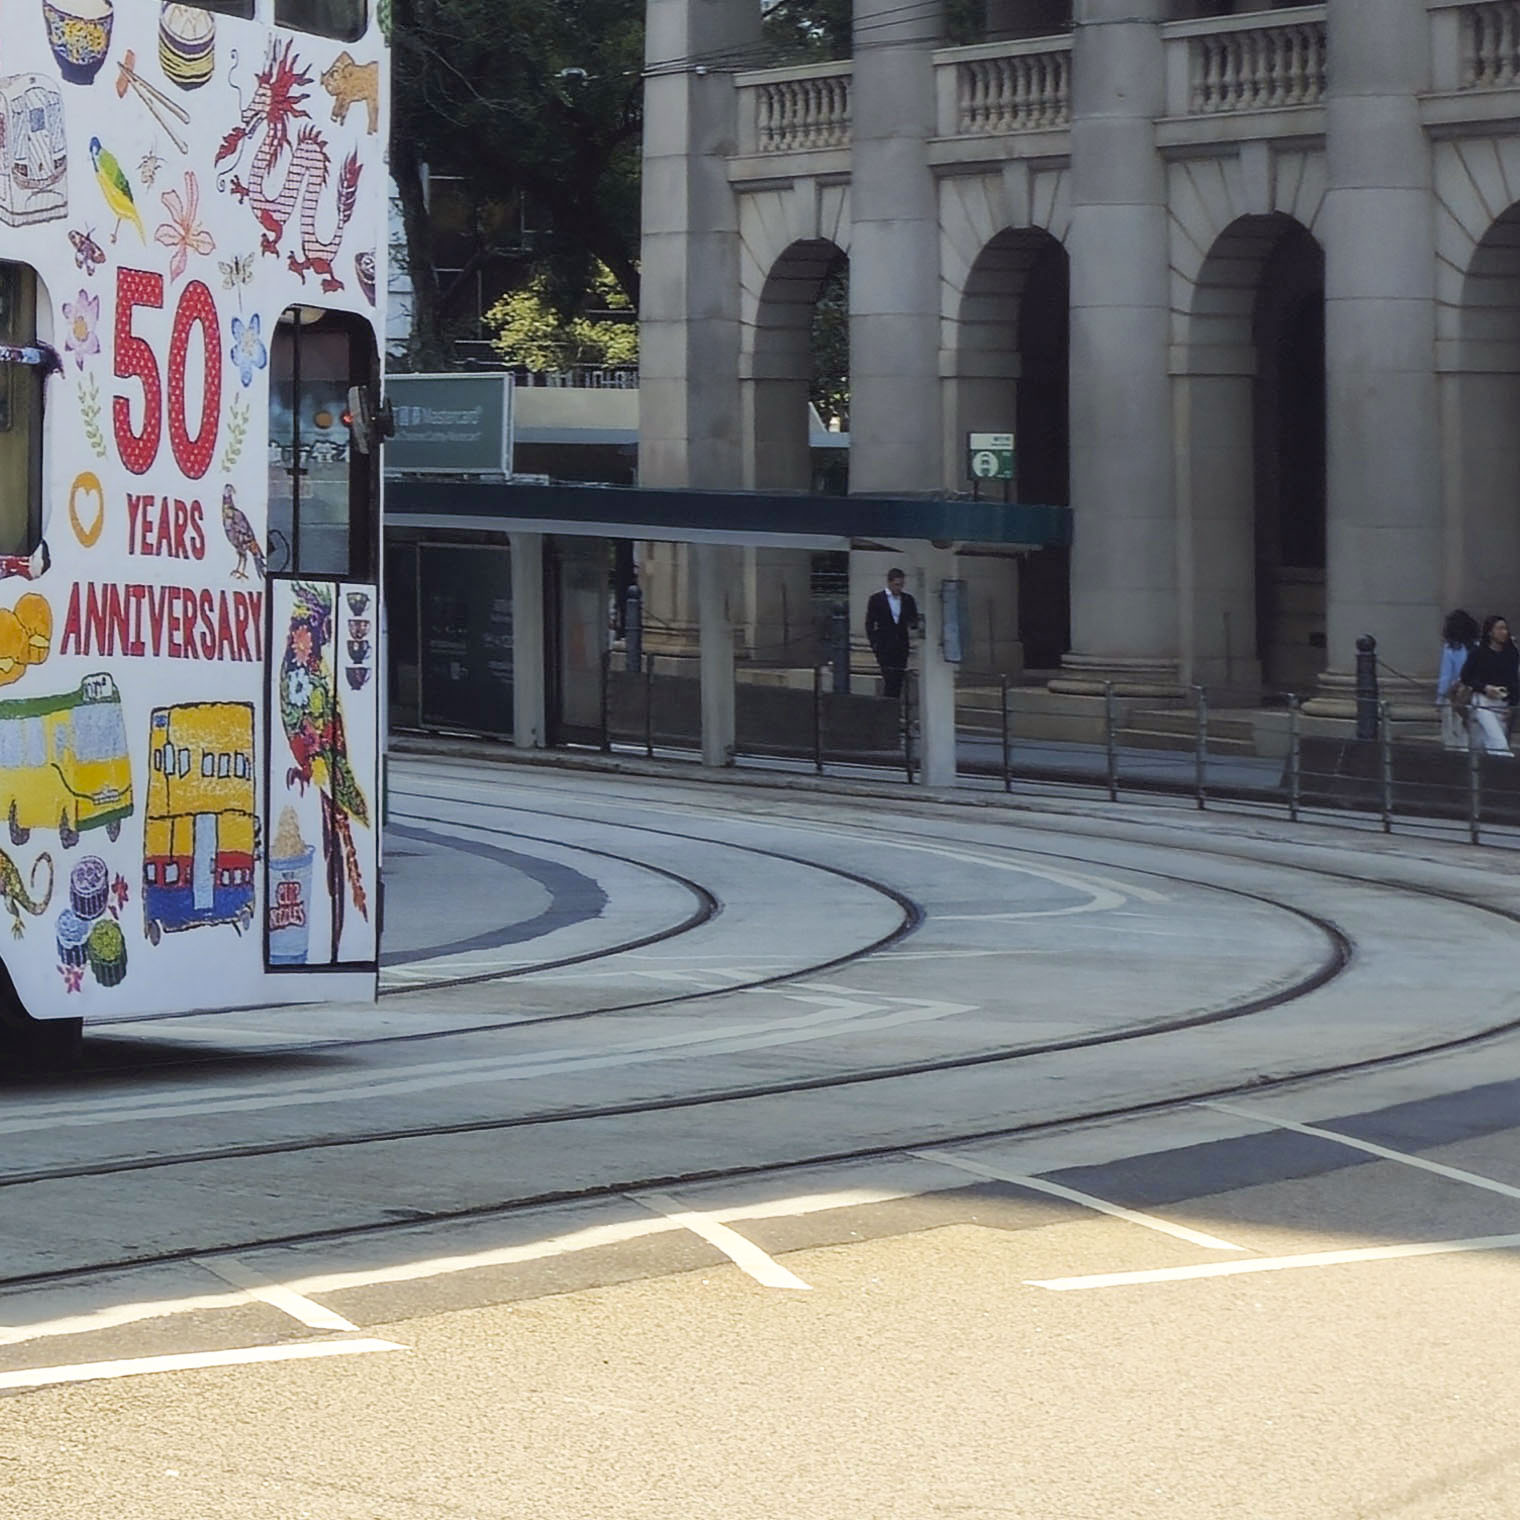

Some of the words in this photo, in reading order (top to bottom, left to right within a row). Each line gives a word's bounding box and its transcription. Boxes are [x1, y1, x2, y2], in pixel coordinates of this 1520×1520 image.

[113, 266, 222, 480] 50
[126, 493, 205, 560] YEARS
[59, 582, 264, 662] ANNIVERSARY
